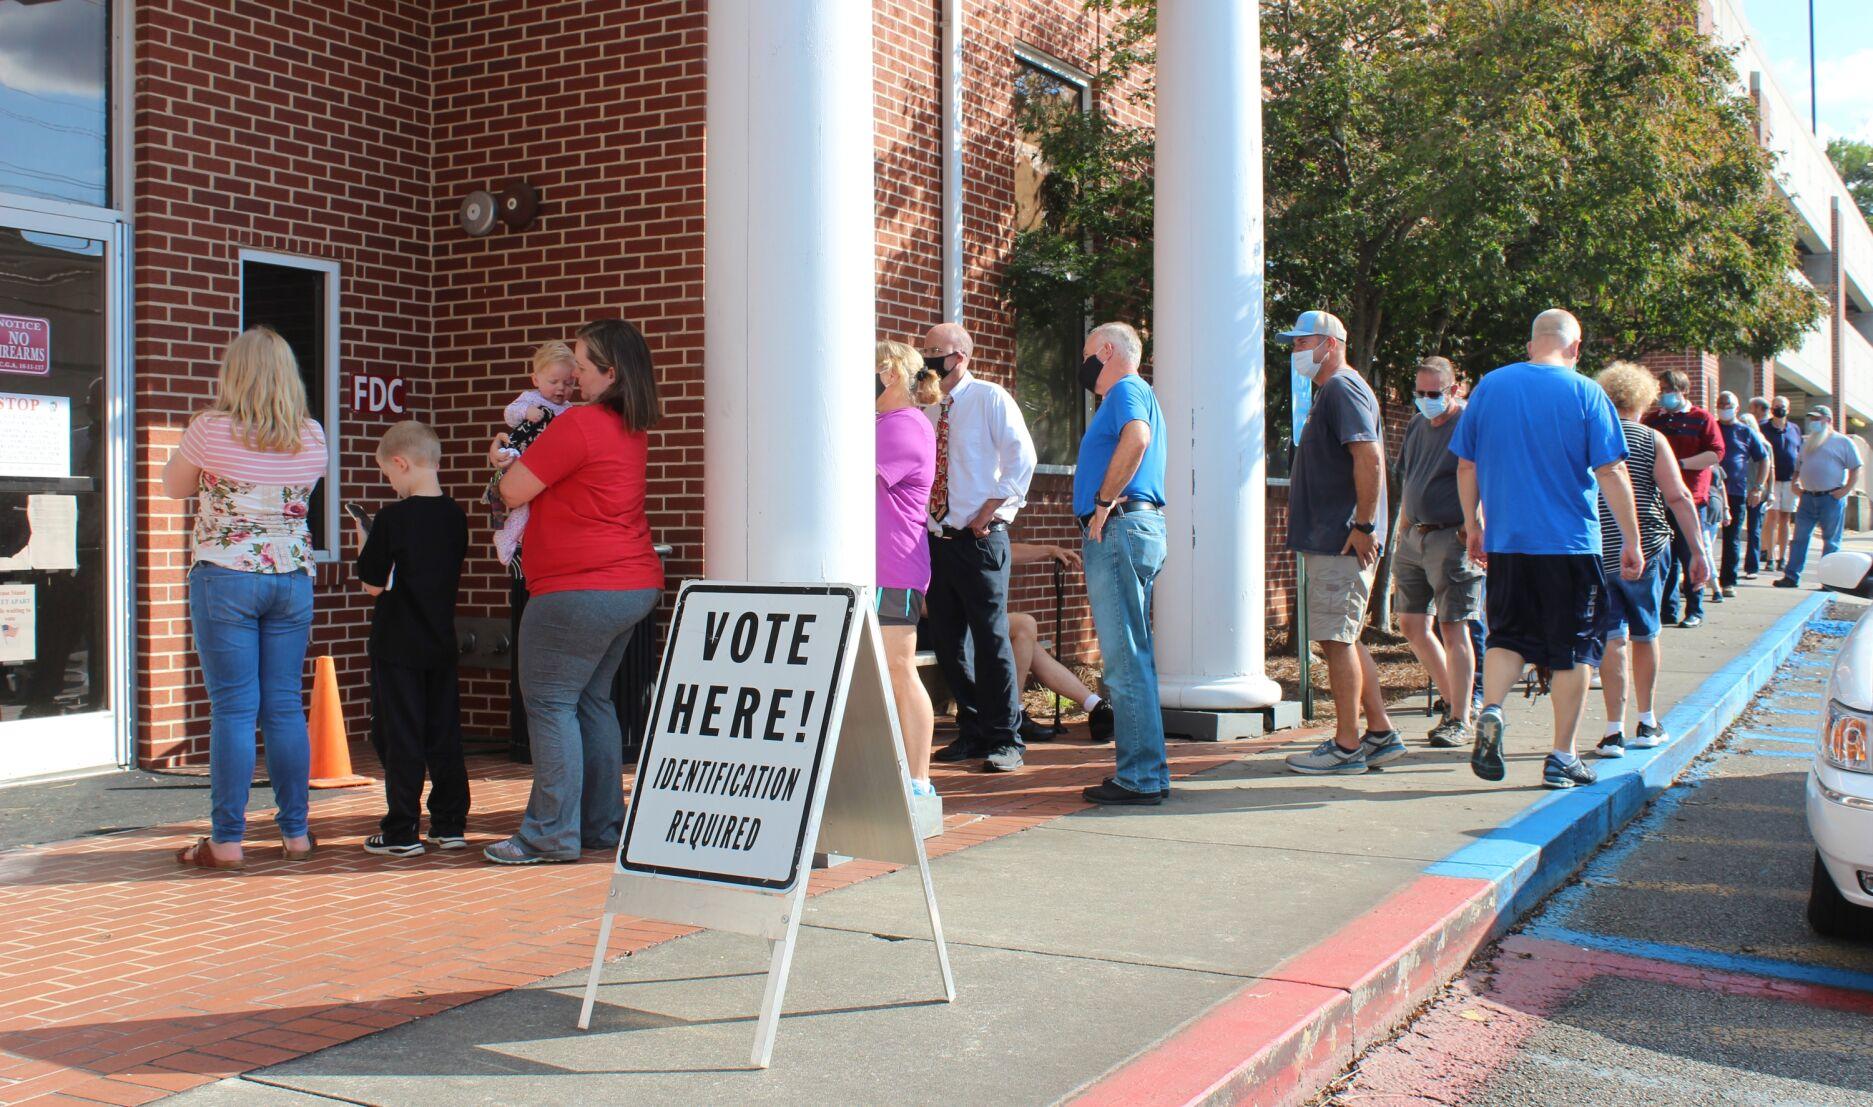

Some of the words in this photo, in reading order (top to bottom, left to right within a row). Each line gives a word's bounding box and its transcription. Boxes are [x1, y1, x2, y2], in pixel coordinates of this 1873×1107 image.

[0, 344, 45, 361] IREARMS
[8, 330, 30, 346] NO
[354, 375, 403, 413] FDC
[702, 611, 817, 665] VOTE
[667, 683, 815, 743] HERE!
[652, 757, 801, 801] IDENTIFICATION
[665, 809, 761, 851] REQUIRED
